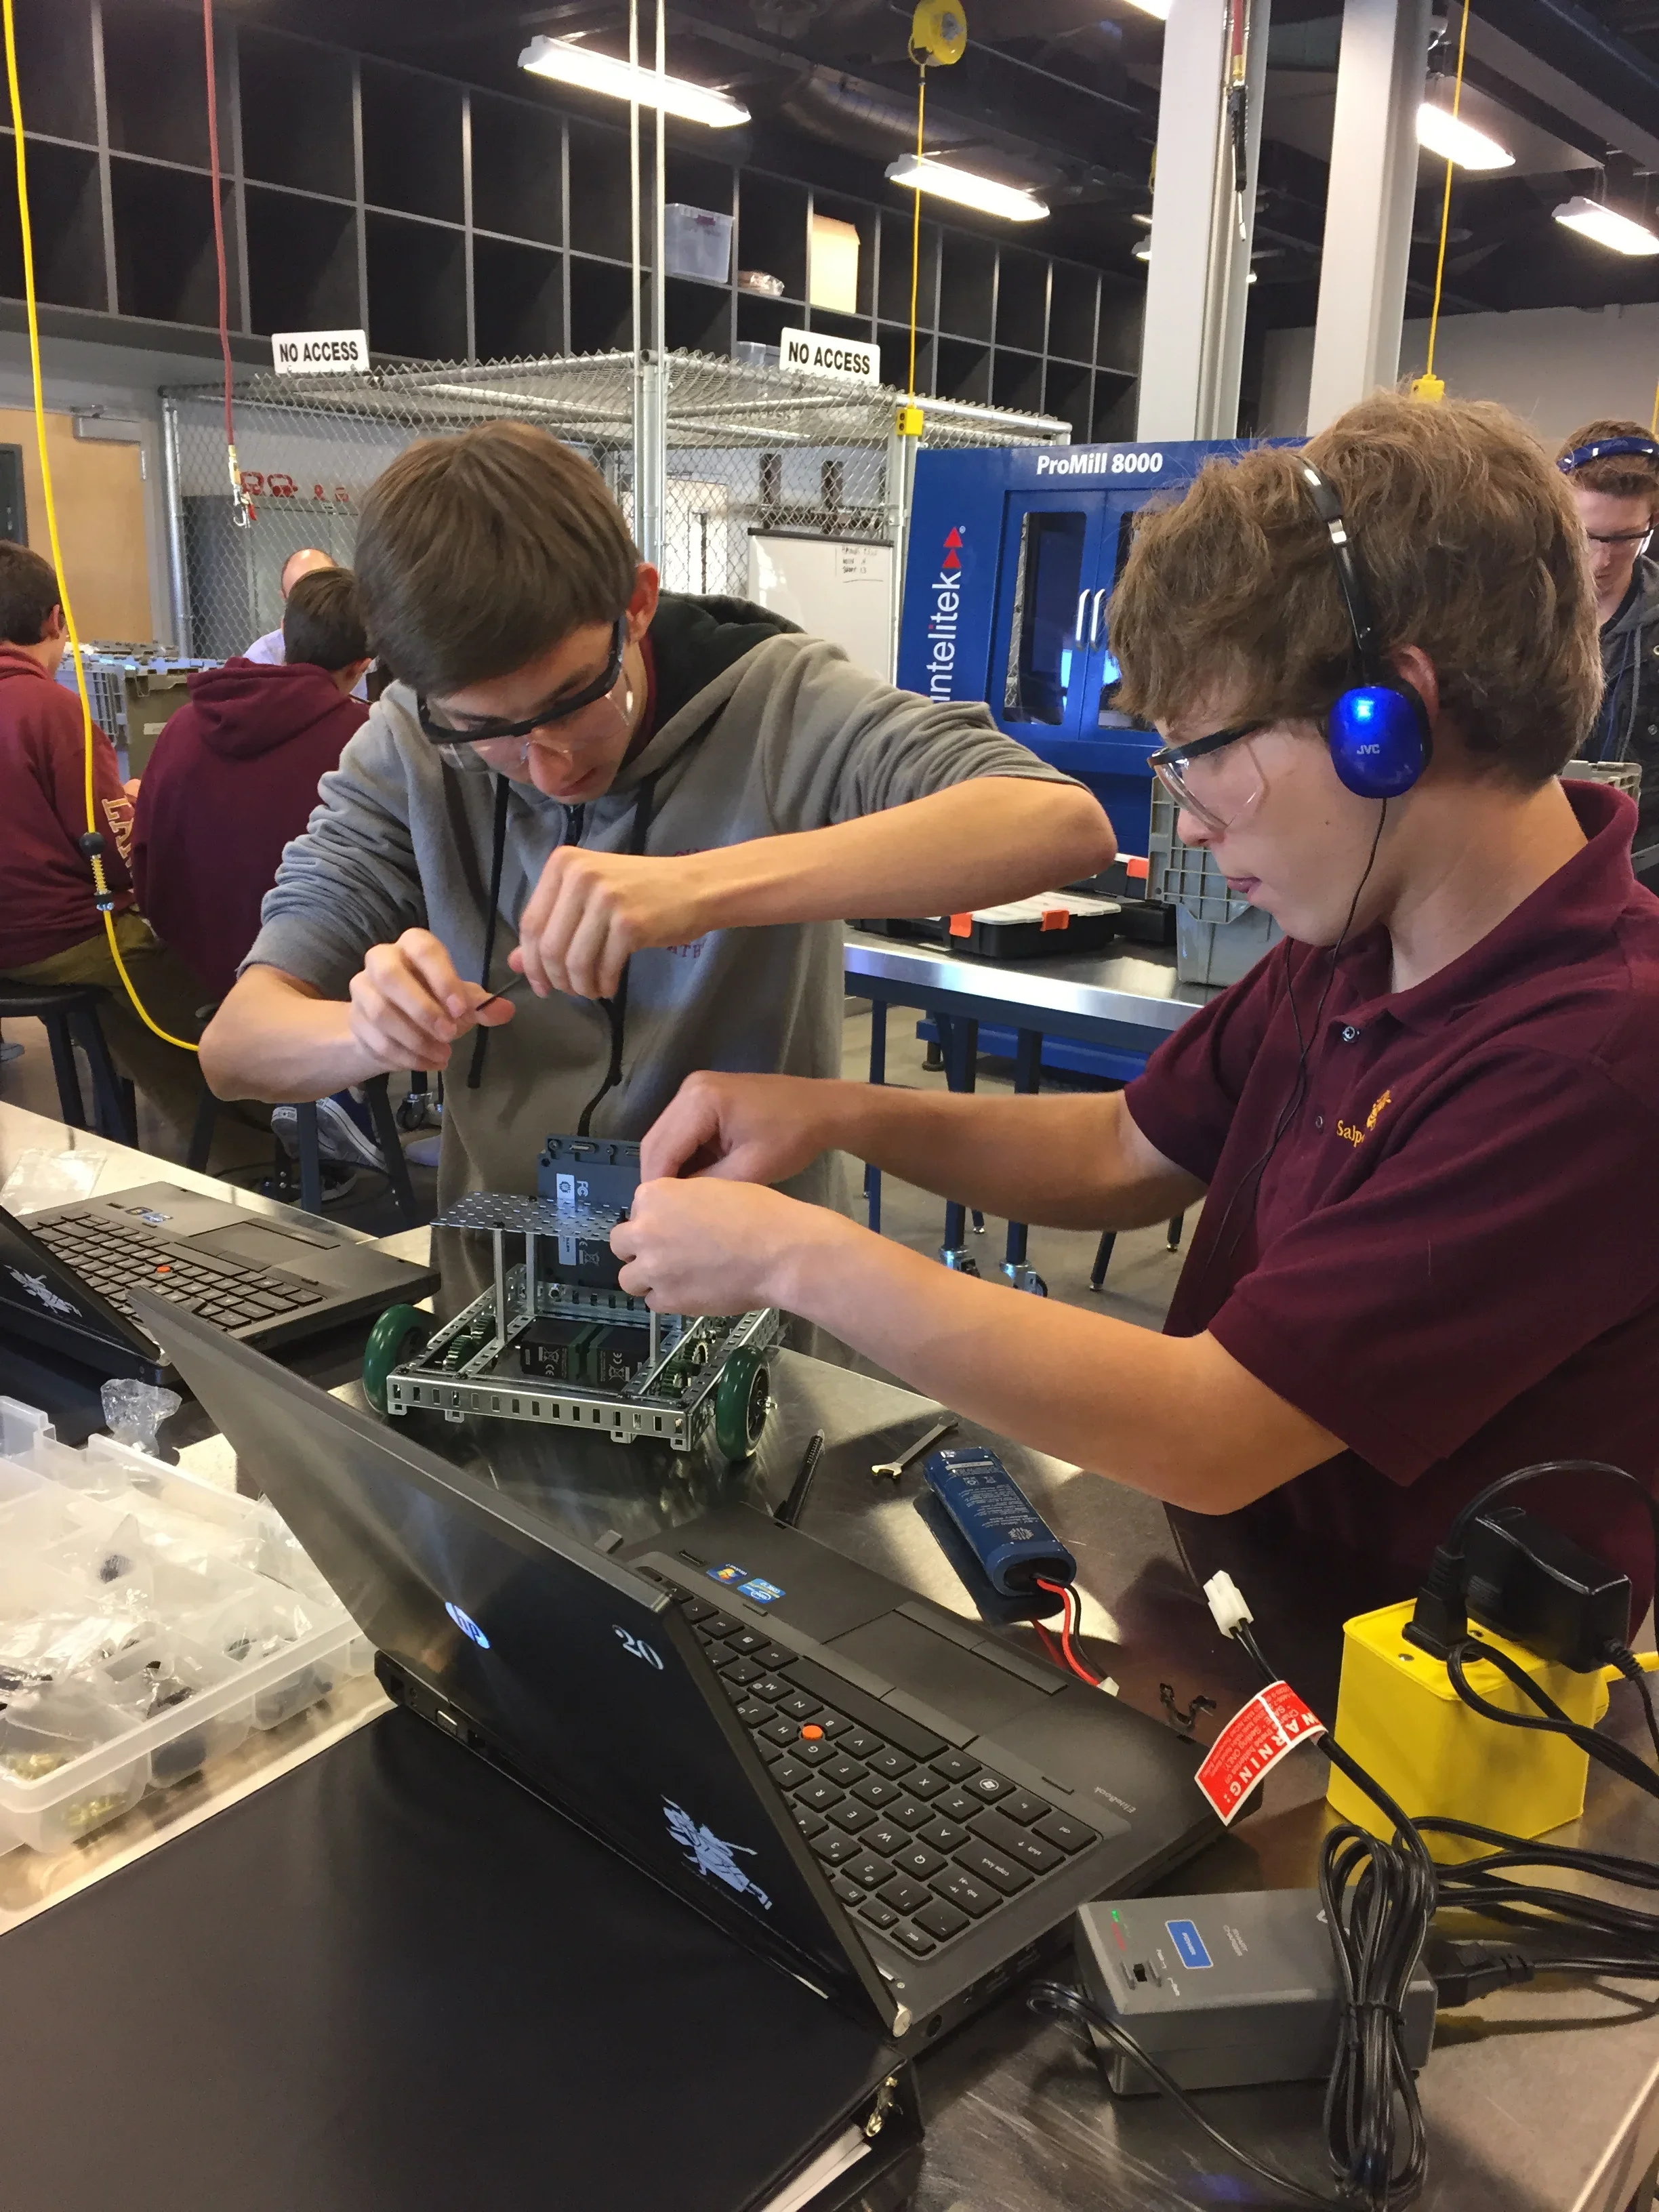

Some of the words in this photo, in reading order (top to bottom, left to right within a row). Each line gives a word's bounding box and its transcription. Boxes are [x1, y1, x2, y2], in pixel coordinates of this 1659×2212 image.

[279, 343, 298, 362] NO
[303, 341, 359, 361] ACCESS
[788, 341, 809, 364] NO
[813, 346, 870, 375] ACCESS
[1036, 452, 1107, 475] ProMill
[1111, 452, 1163, 473] 8000
[1357, 744, 1380, 755] JVC
[449, 1602, 485, 1645] hp
[613, 1624, 663, 1670] 20
[815, 1789, 825, 1797] R
[878, 1832, 891, 1842] W
[914, 1855, 925, 1864] Q
